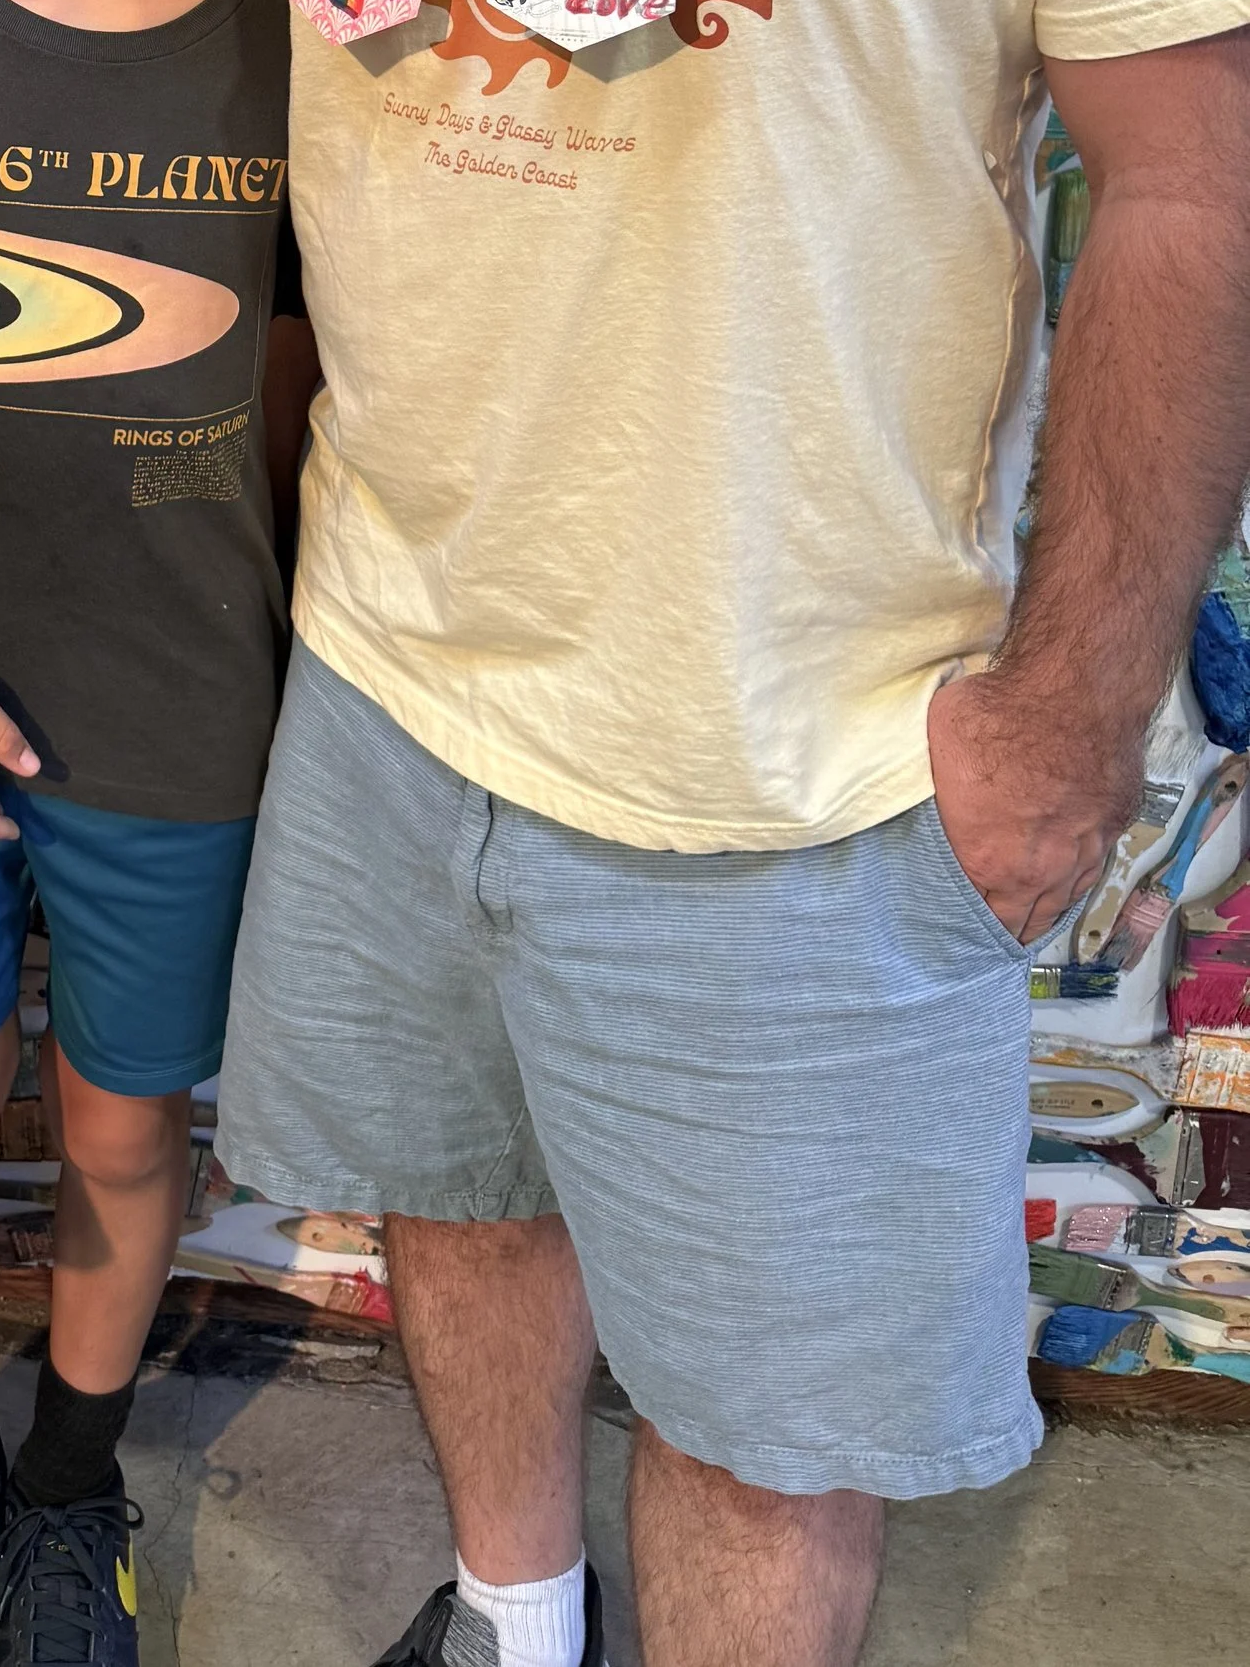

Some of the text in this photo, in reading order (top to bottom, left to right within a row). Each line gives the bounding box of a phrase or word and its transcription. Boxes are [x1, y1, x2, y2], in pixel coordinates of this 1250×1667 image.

[383, 92, 637, 153] Sunny Days & Glassy Waves
[86, 151, 288, 202] PLANET
[424, 141, 578, 190] The Golden Coast
[113, 409, 250, 446] RINGS OF SATURN
